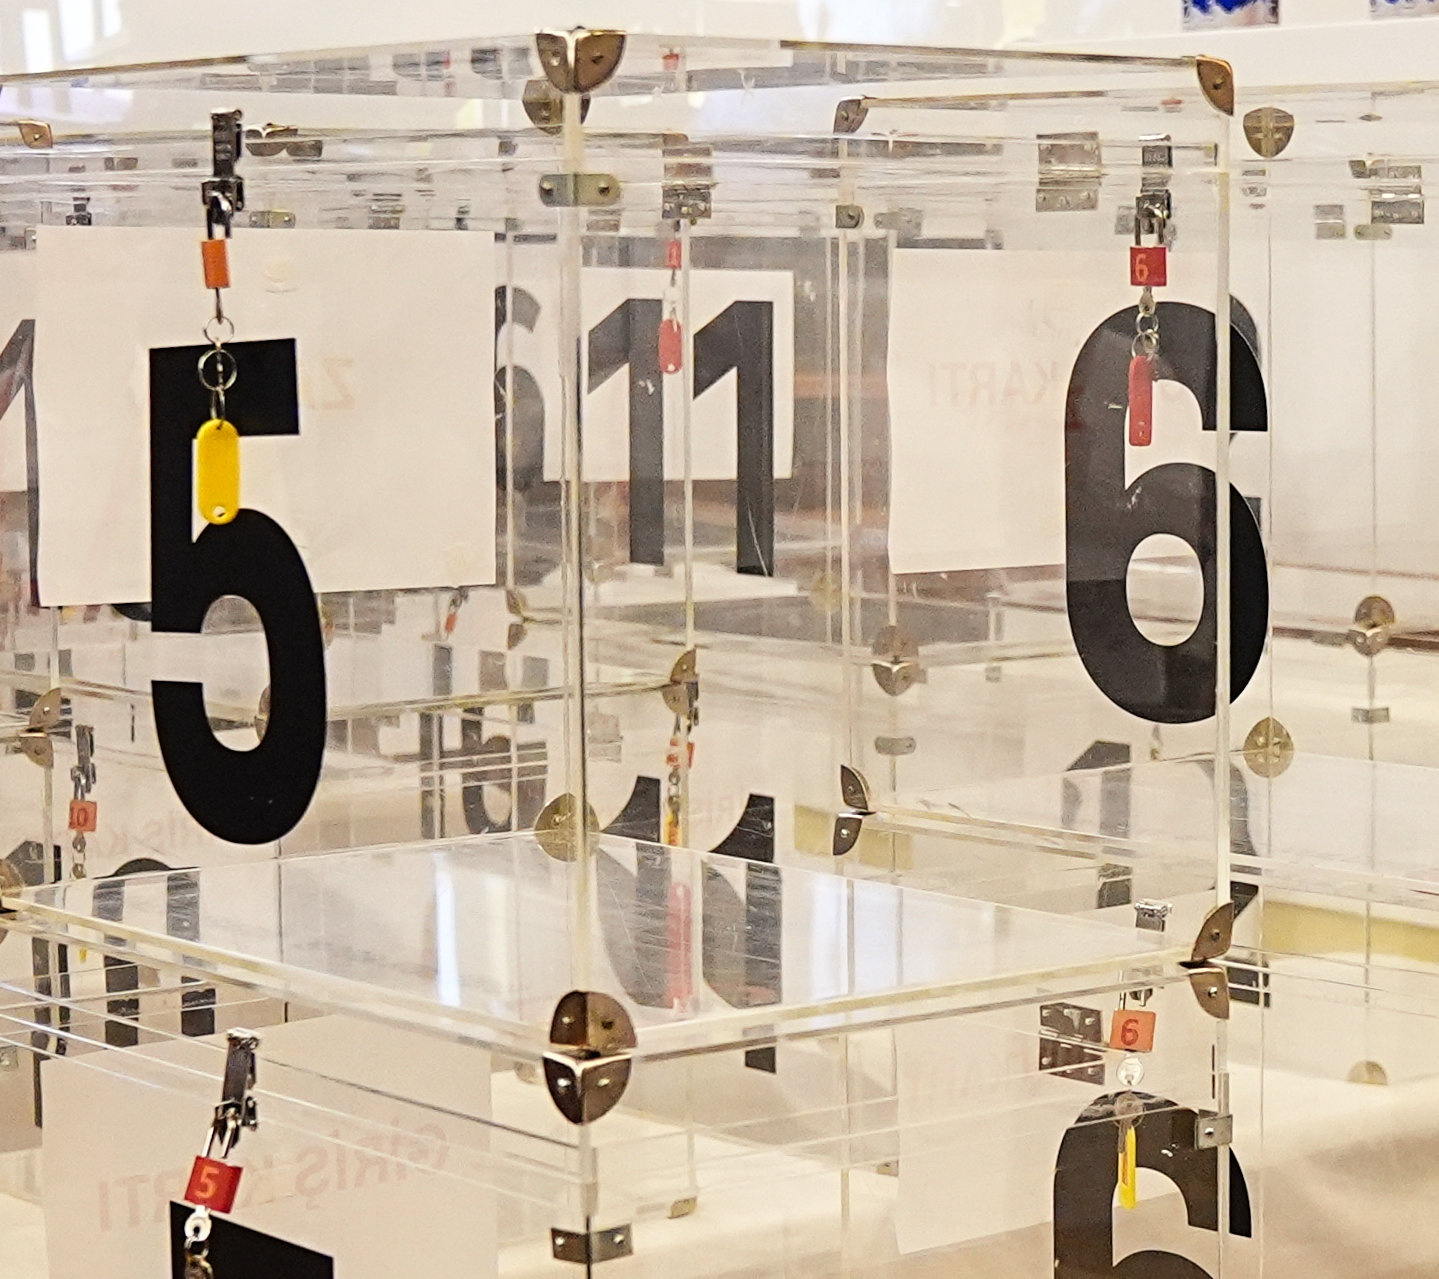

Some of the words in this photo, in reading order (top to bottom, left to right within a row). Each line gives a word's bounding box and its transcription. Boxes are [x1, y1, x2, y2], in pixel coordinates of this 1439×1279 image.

[1135, 253, 1149, 282] 6
[587, 297, 774, 577] 11
[1064, 300, 1270, 724] 6
[149, 337, 327, 846] 5
[1121, 1018, 1139, 1046] 6
[194, 1164, 220, 1200] 5
